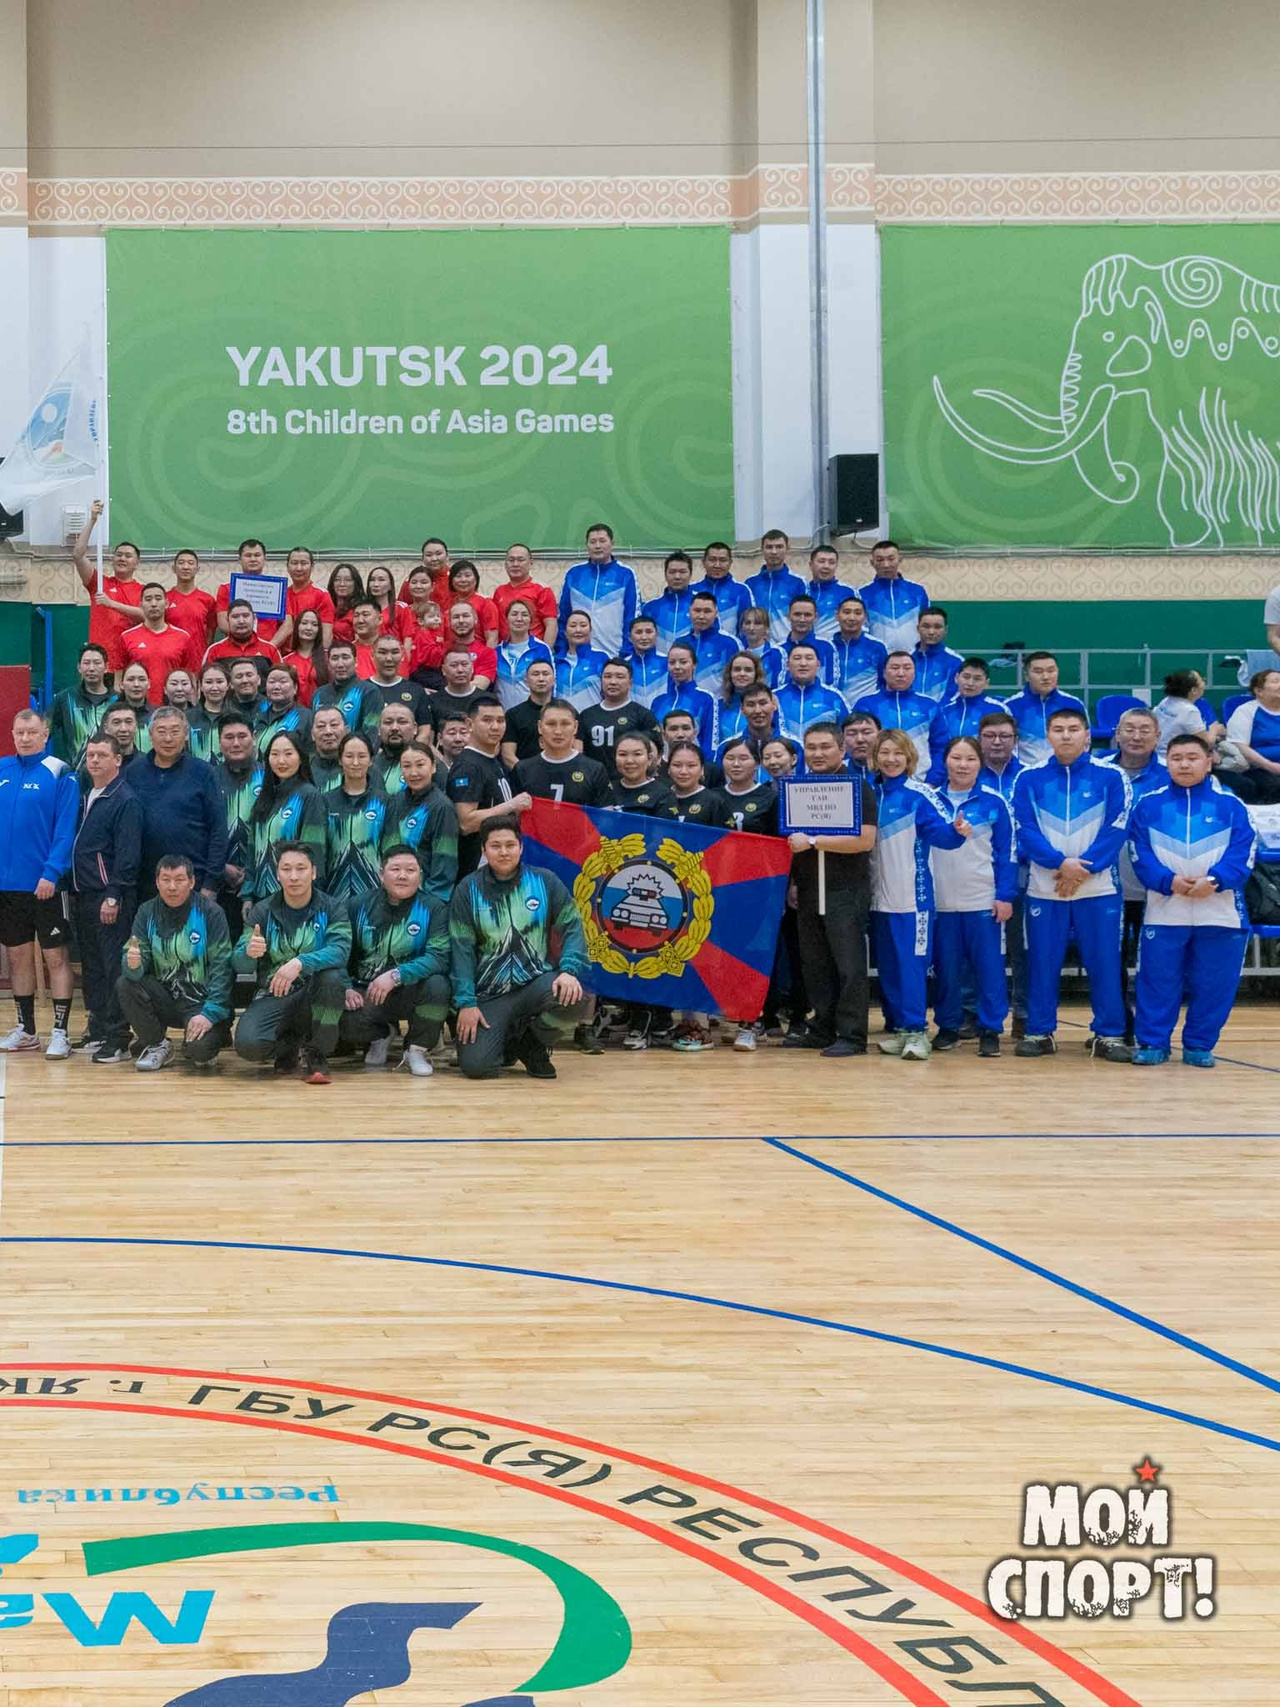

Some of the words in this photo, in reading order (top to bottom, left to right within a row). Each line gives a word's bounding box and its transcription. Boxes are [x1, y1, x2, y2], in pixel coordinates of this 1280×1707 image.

[225, 345, 468, 387] YAKUTSK
[479, 344, 613, 386] 2024
[227, 408, 278, 435] 8th
[285, 408, 404, 435] Children
[410, 408, 441, 434] of
[446, 408, 508, 434] Asia
[515, 408, 614, 435] Games
[591, 725, 614, 747] 91
[550, 783, 564, 803] 7
[187, 1385, 355, 1420] ГБУ
[367, 1412, 612, 1487] РС(Я)
[16, 1484, 341, 1506] Республика
